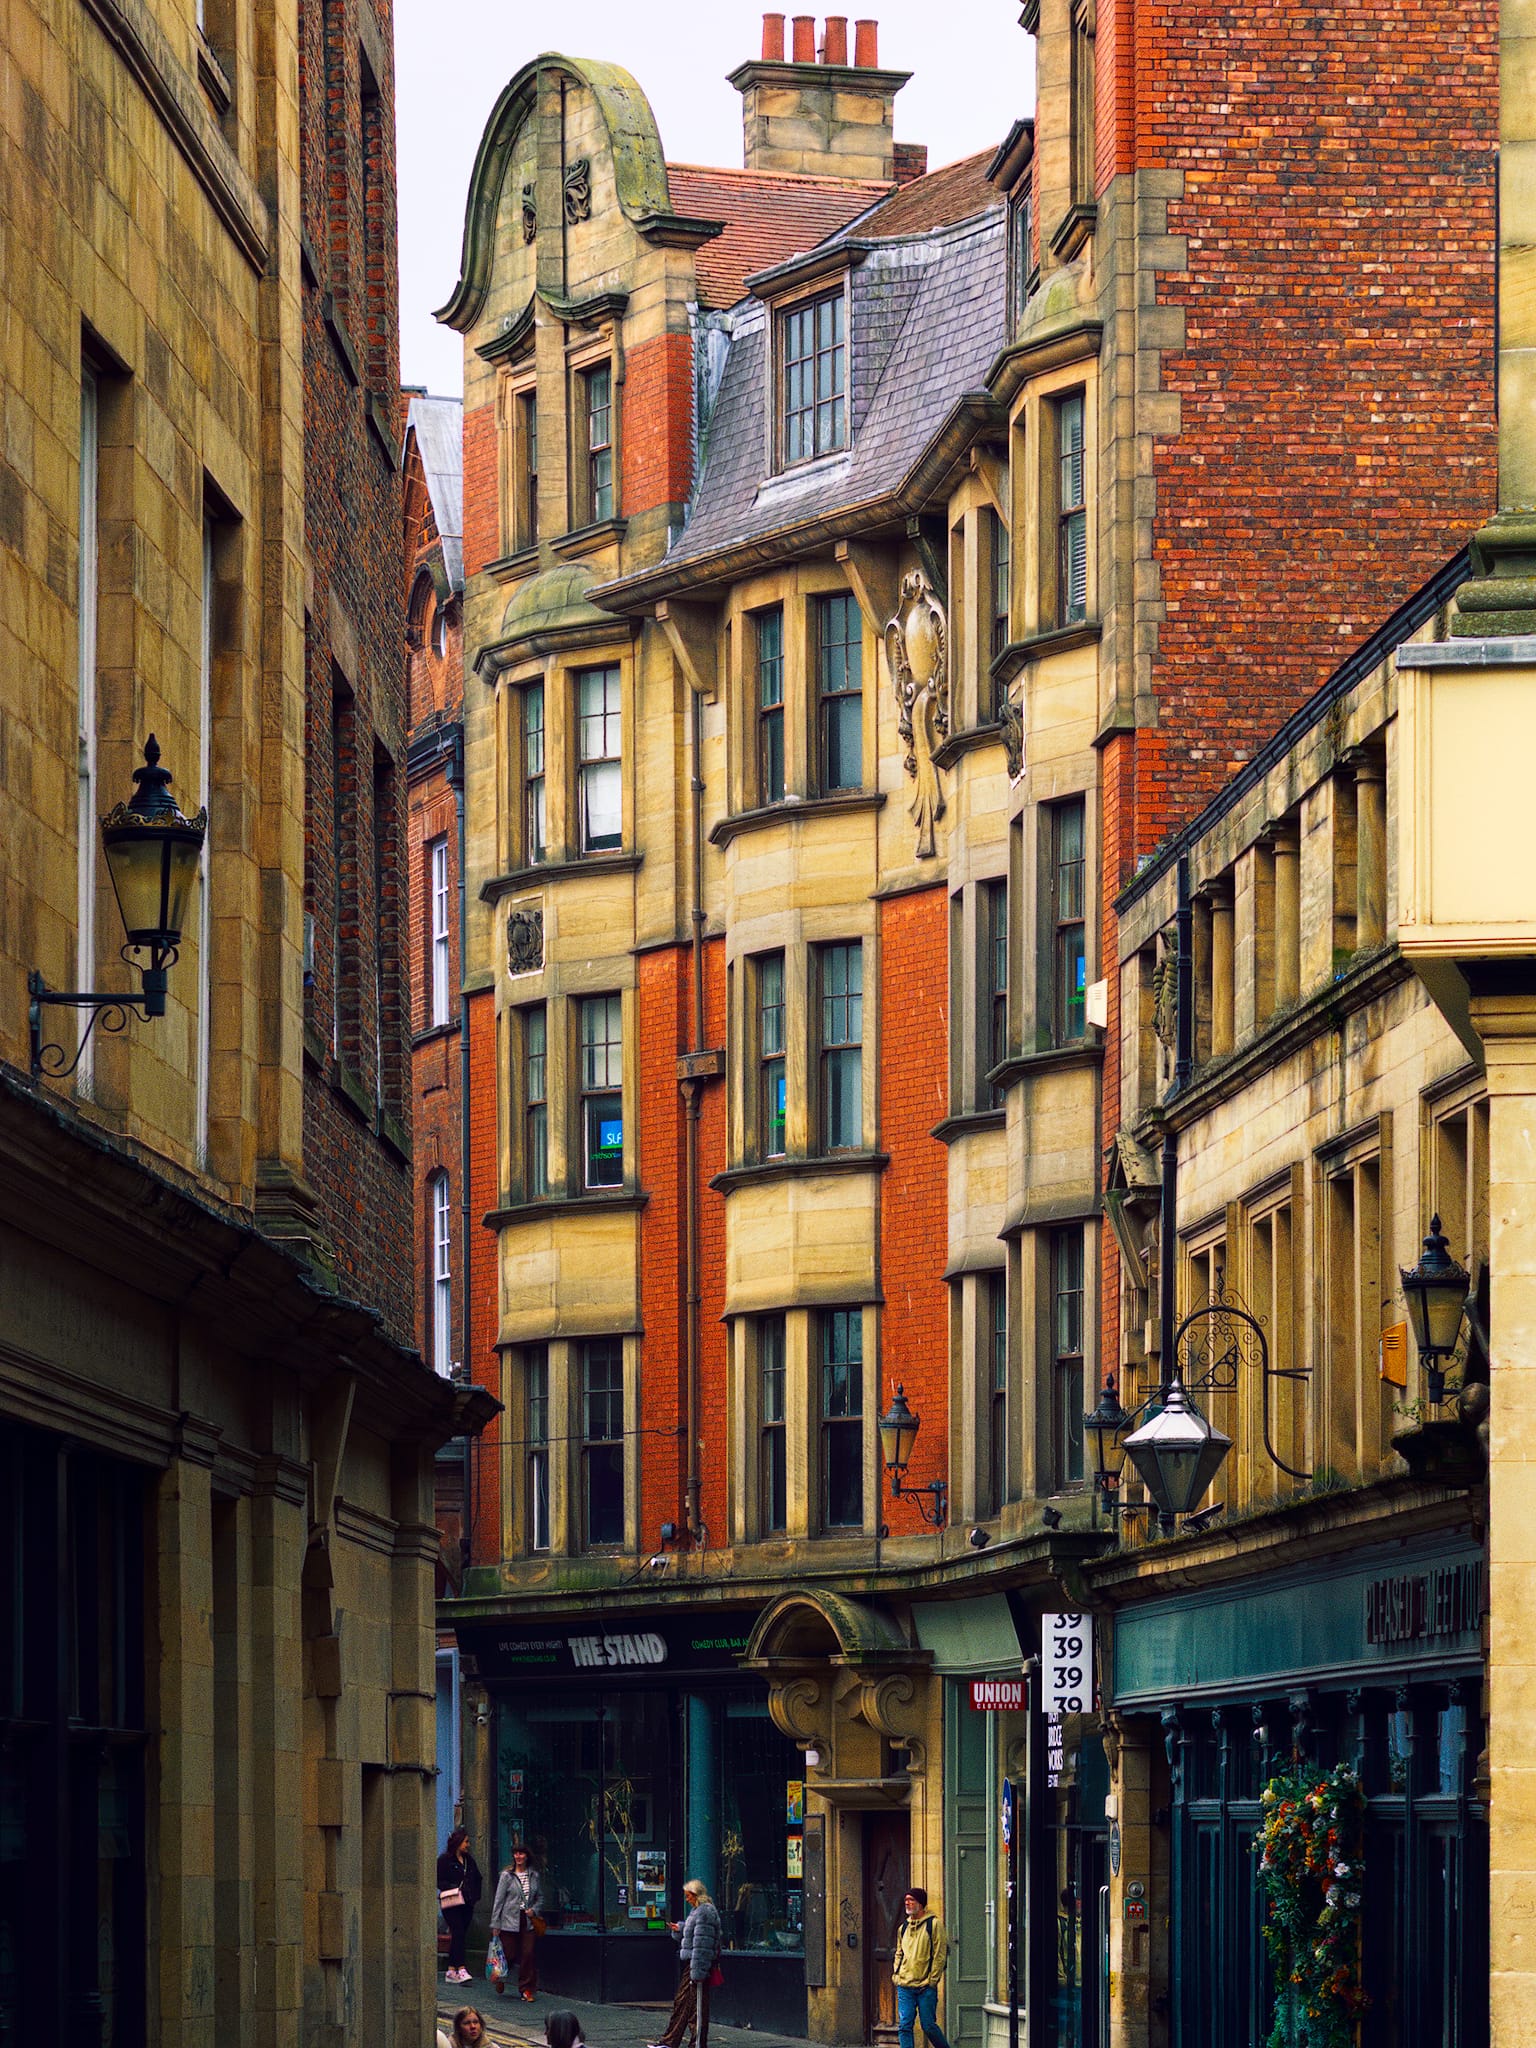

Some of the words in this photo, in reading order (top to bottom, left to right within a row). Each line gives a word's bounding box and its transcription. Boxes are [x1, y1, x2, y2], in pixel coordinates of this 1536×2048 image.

[1367, 1576, 1413, 1644] PLEASED
[1428, 1567, 1457, 1635] MEET
[1457, 1561, 1481, 1631] YOU
[567, 1635, 607, 1667] THE
[603, 1632, 667, 1666] STAND
[1053, 1635, 1083, 1659] 39
[1053, 1666, 1083, 1689] 39
[973, 1682, 1022, 1703] UNION
[976, 1702, 1019, 1710] CLOTHING
[1053, 1696, 1083, 1713] 39
